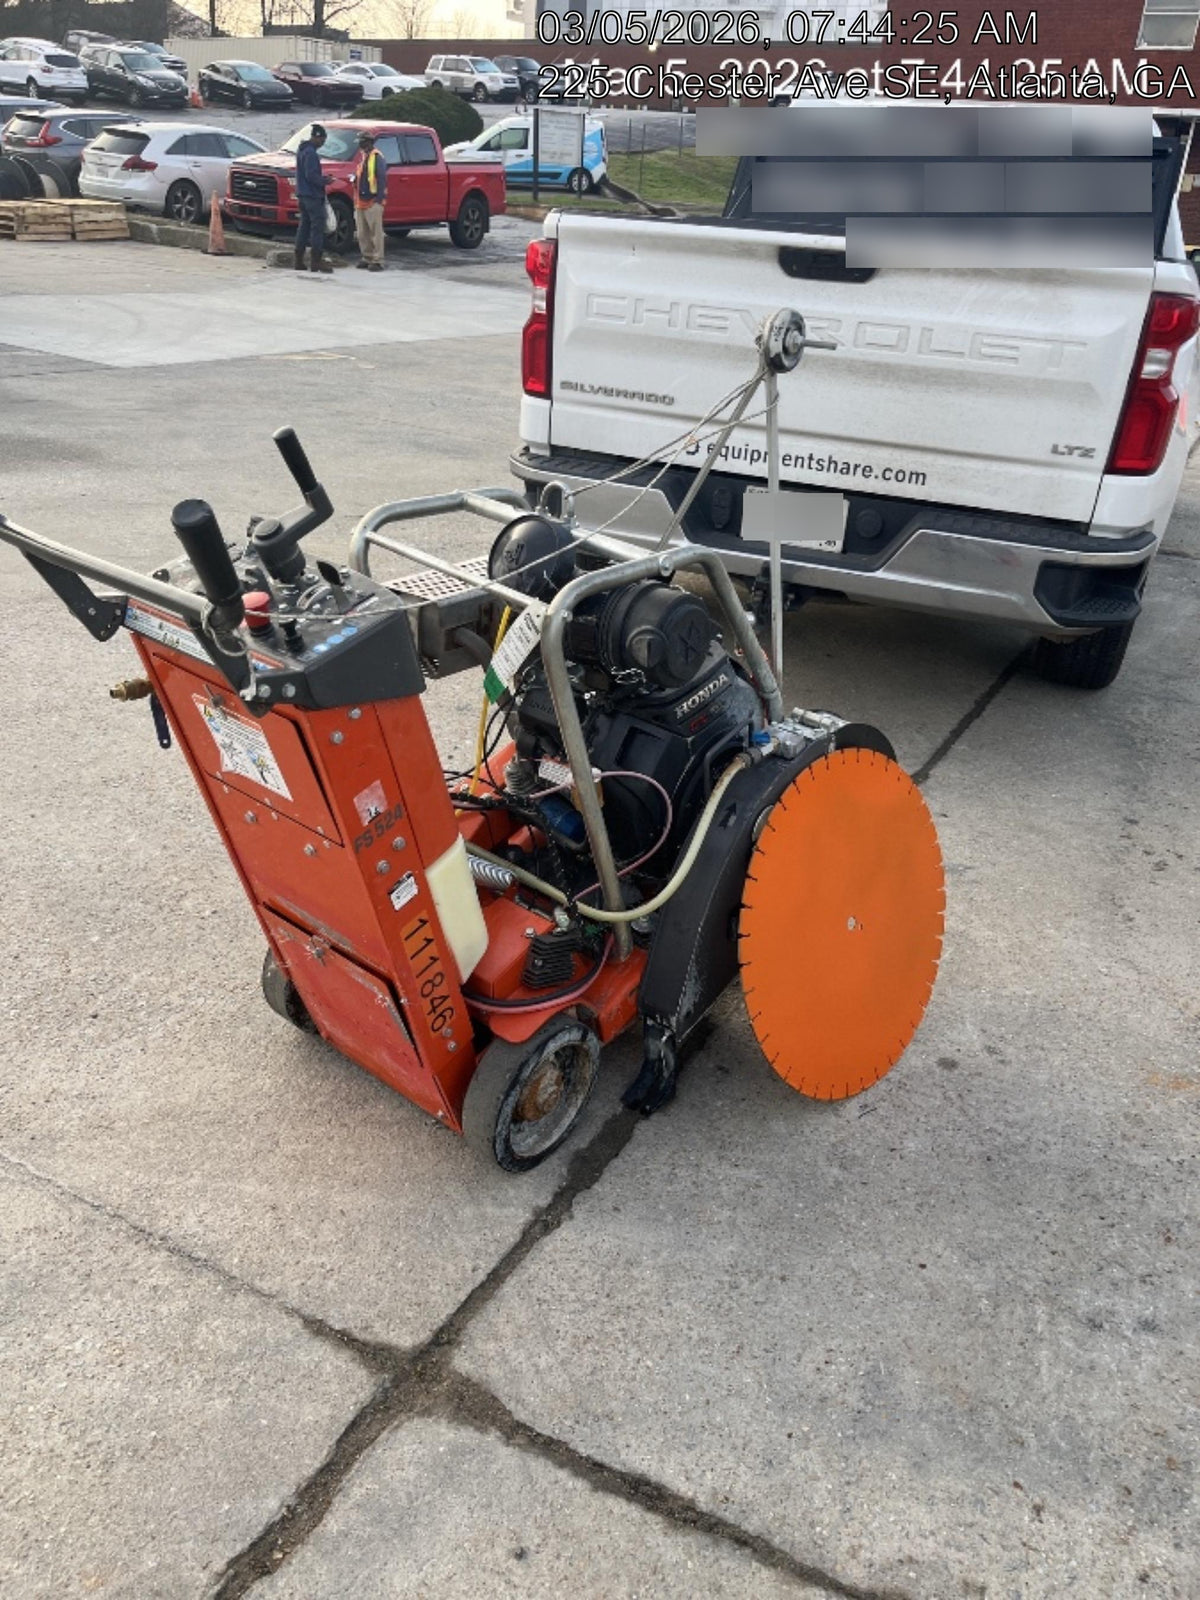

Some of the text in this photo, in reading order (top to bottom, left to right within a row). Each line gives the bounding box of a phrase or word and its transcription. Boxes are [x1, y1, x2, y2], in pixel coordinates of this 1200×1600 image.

[560, 380, 675, 406] SILVERADO
[706, 442, 928, 487] equipentshare.com
[1050, 443, 1096, 459] LTZ
[674, 673, 729, 720] HONDA
[354, 828, 374, 854] FS
[374, 803, 404, 839] 524
[404, 918, 455, 1033] 111846
